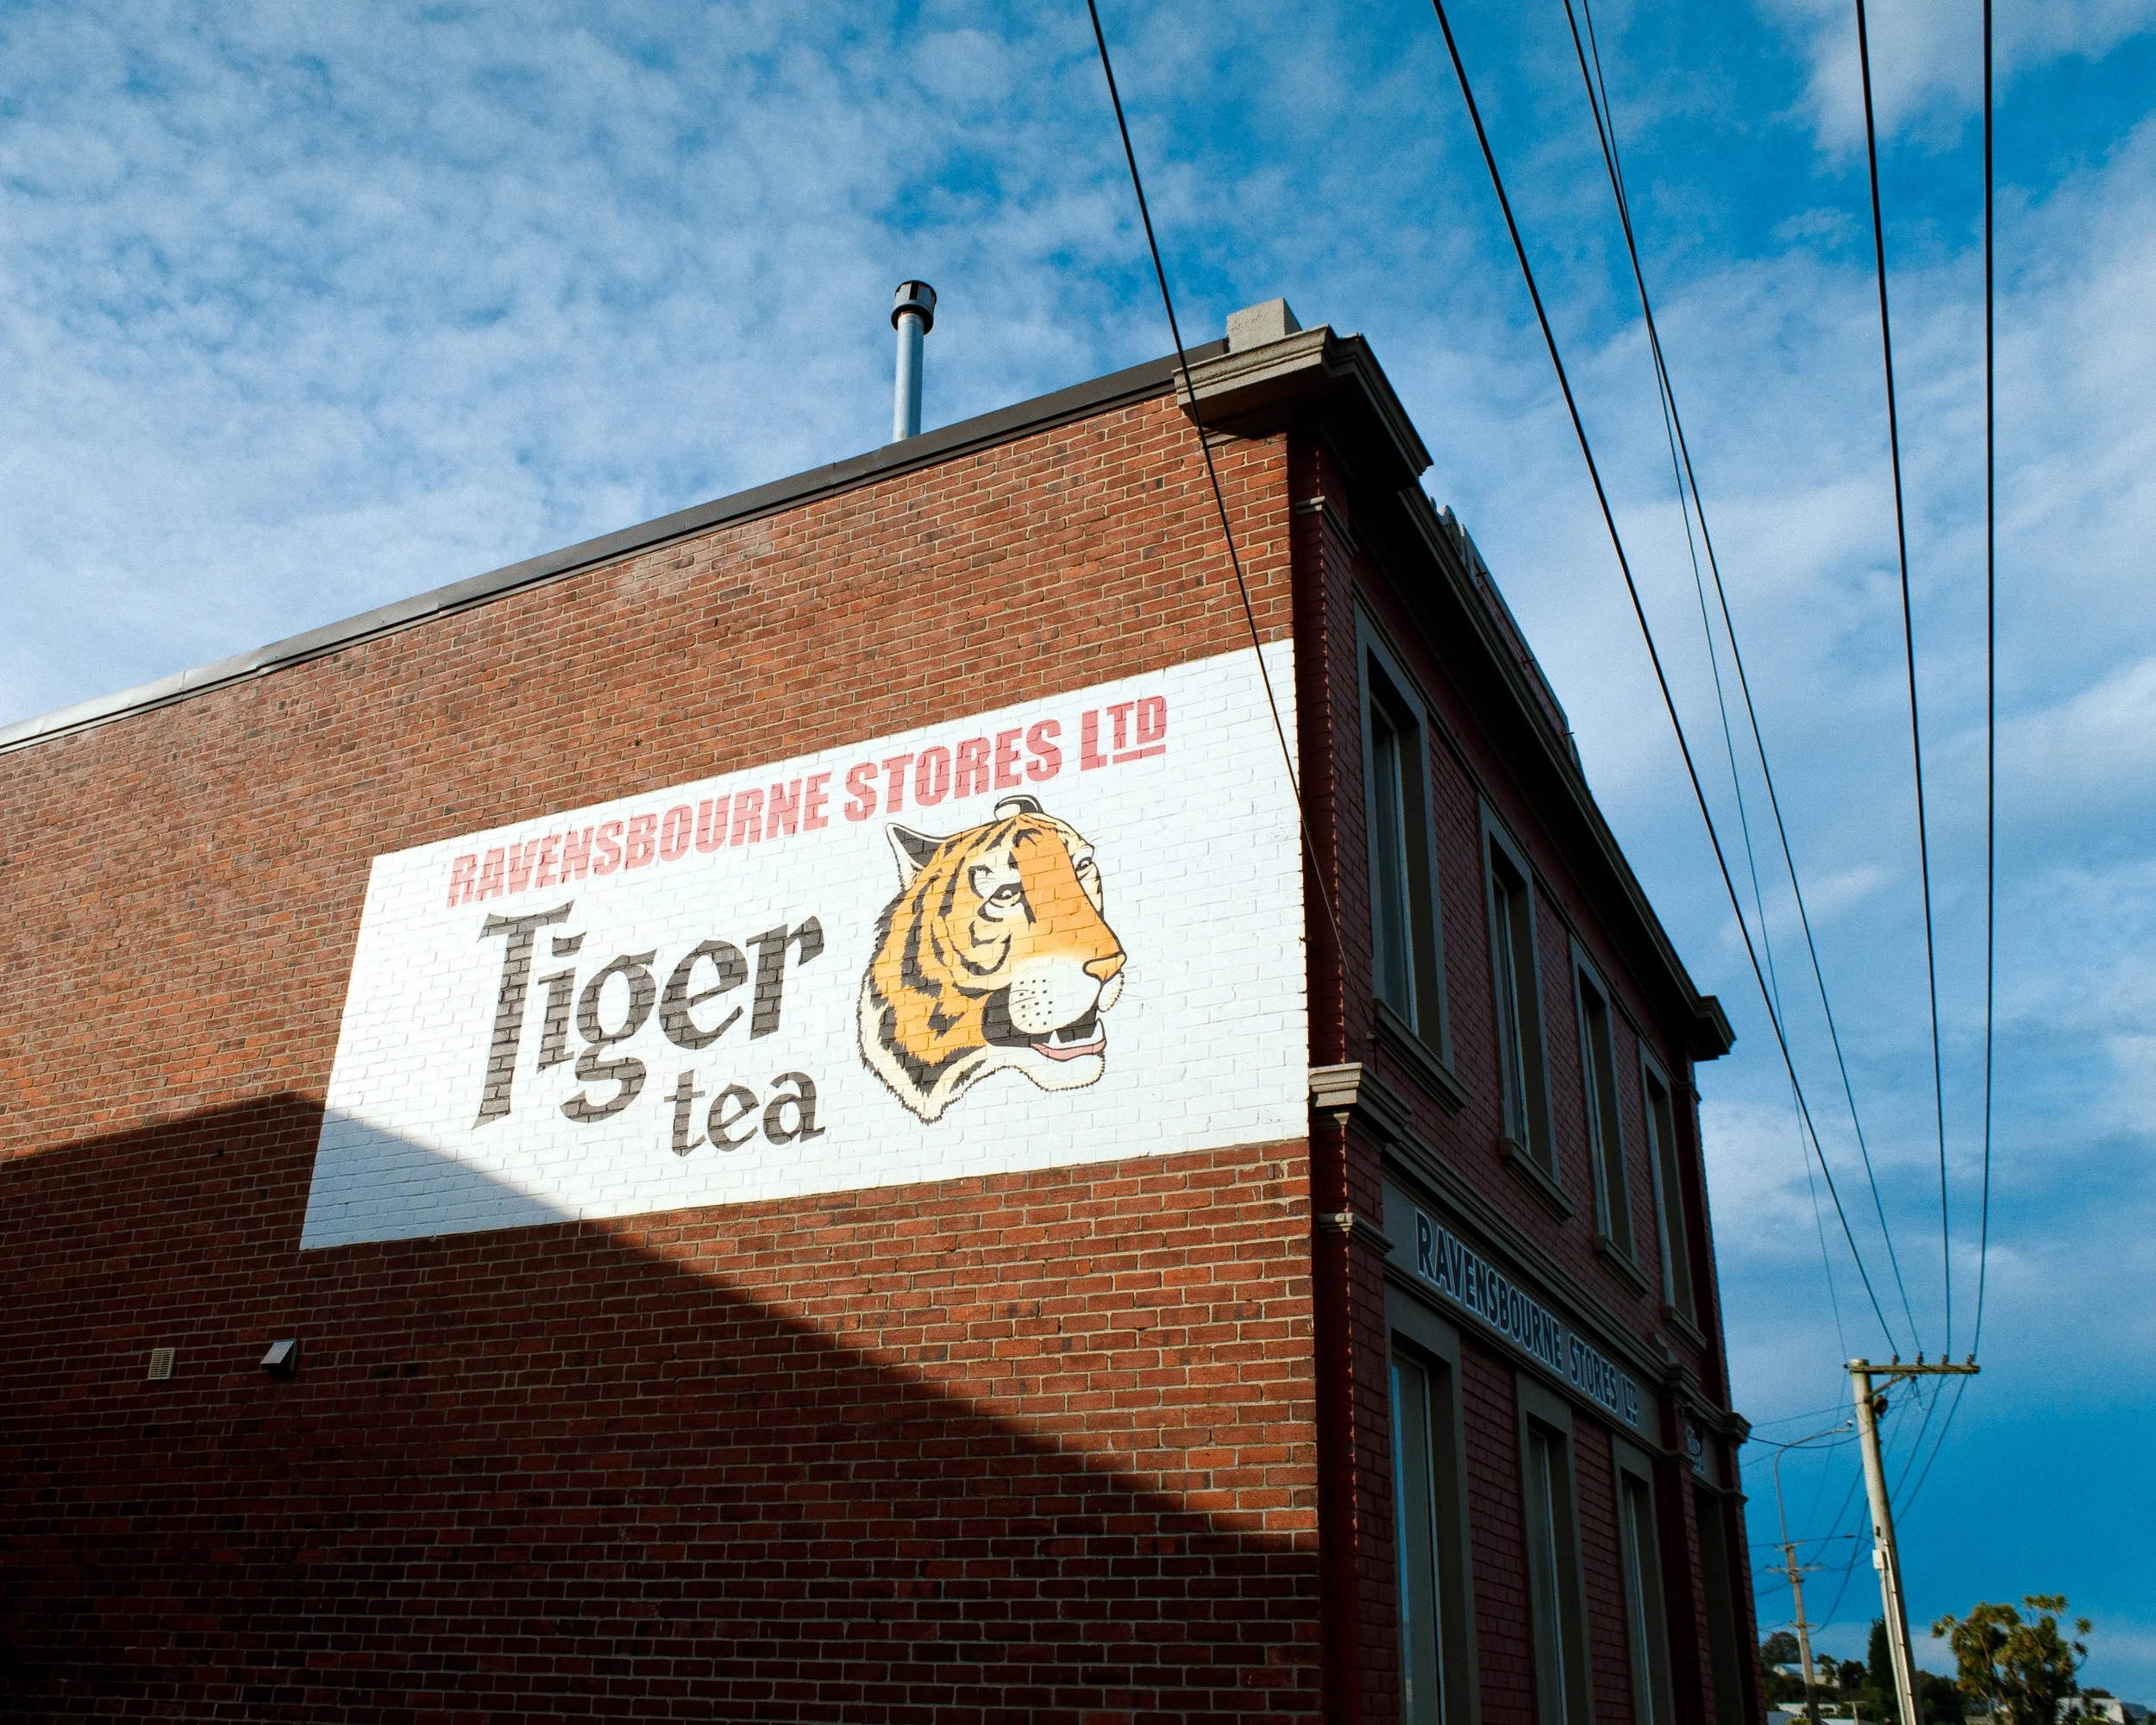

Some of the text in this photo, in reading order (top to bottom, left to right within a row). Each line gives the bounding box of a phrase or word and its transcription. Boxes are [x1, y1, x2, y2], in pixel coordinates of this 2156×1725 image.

[446, 772, 830, 907] RAVENSBOURNE
[844, 718, 1062, 823] STORES
[471, 899, 825, 1130] Tiger
[664, 1069, 825, 1157] tea
[1415, 1208, 1564, 1374] RAVENSBOURNE
[1569, 1333, 1618, 1413] STORES
